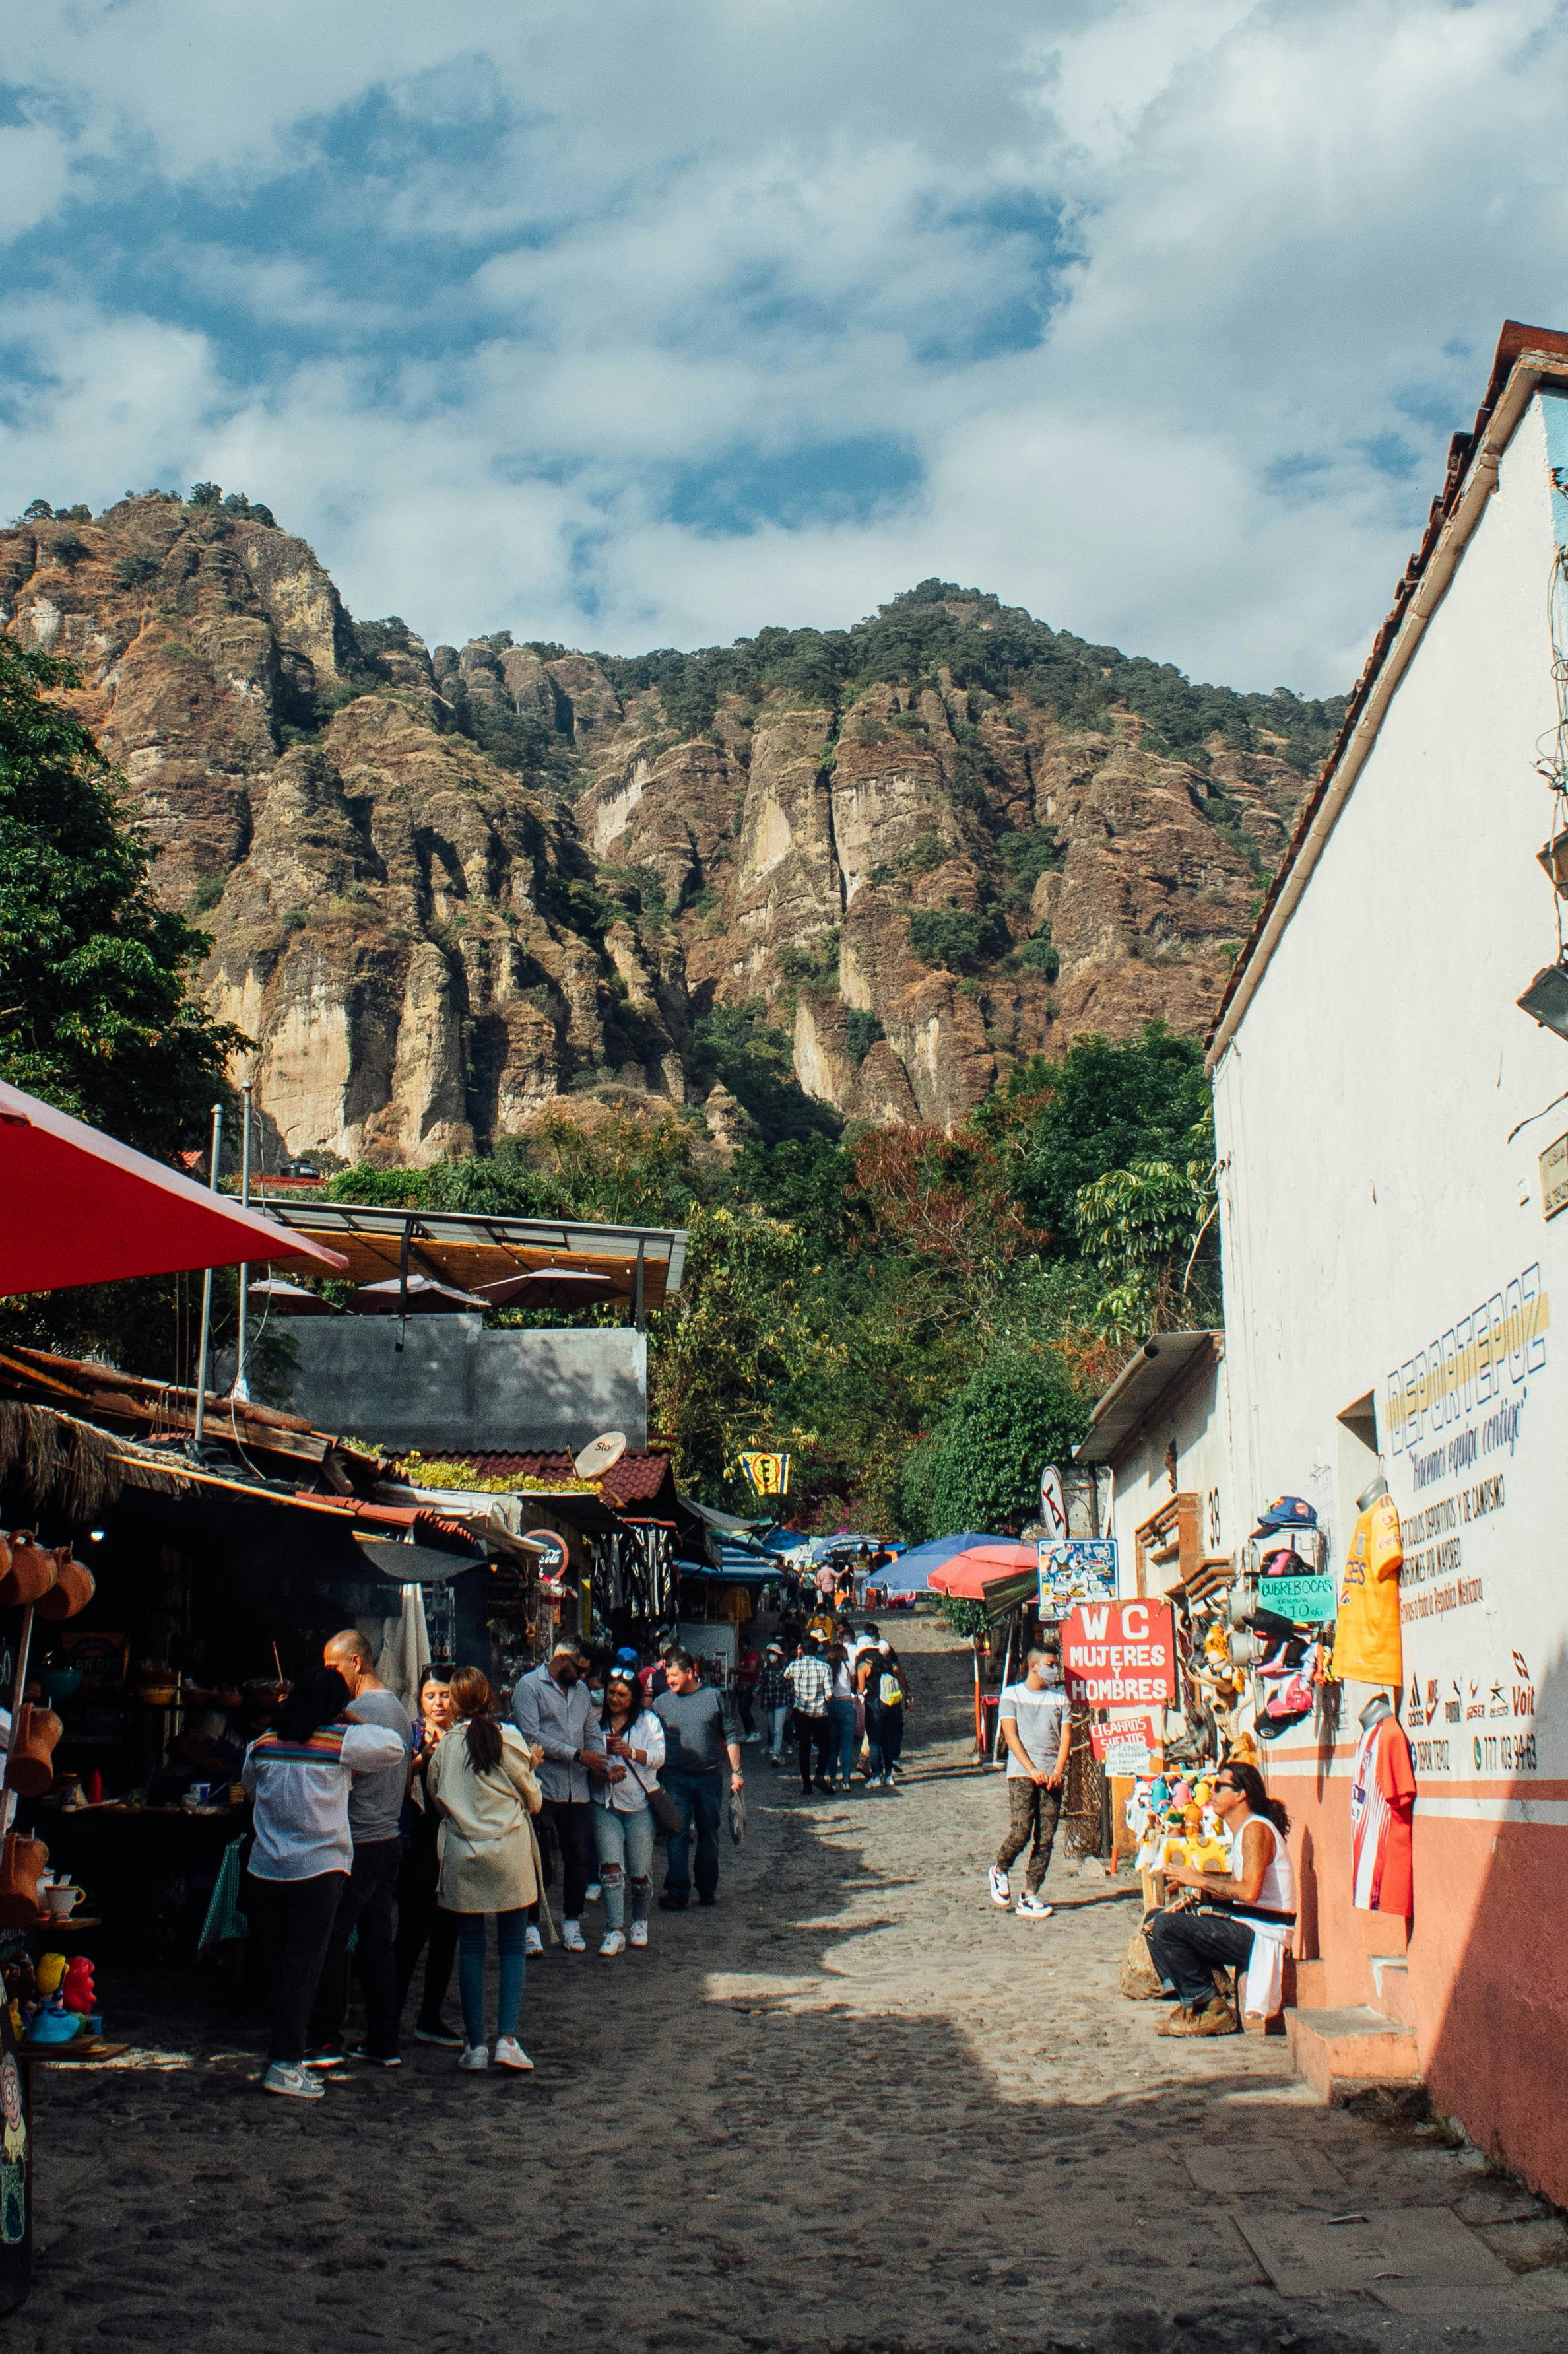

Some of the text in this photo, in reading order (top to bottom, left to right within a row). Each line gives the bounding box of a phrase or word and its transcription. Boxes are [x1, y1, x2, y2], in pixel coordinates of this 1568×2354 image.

[1388, 1261, 1546, 1456] DEPORTEPOZ
[1208, 1486, 1221, 1549] 38
[1262, 1580, 1332, 1597] CUBREBOCAS
[1070, 1644, 1165, 1667] MUJERES
[1112, 1667, 1121, 1679] Y
[1072, 1678, 1167, 1700] HOMBRES
[1512, 1685, 1535, 1716] Voit
[1091, 1718, 1146, 1737] CIGARROS
[1484, 1735, 1497, 1770] 777
